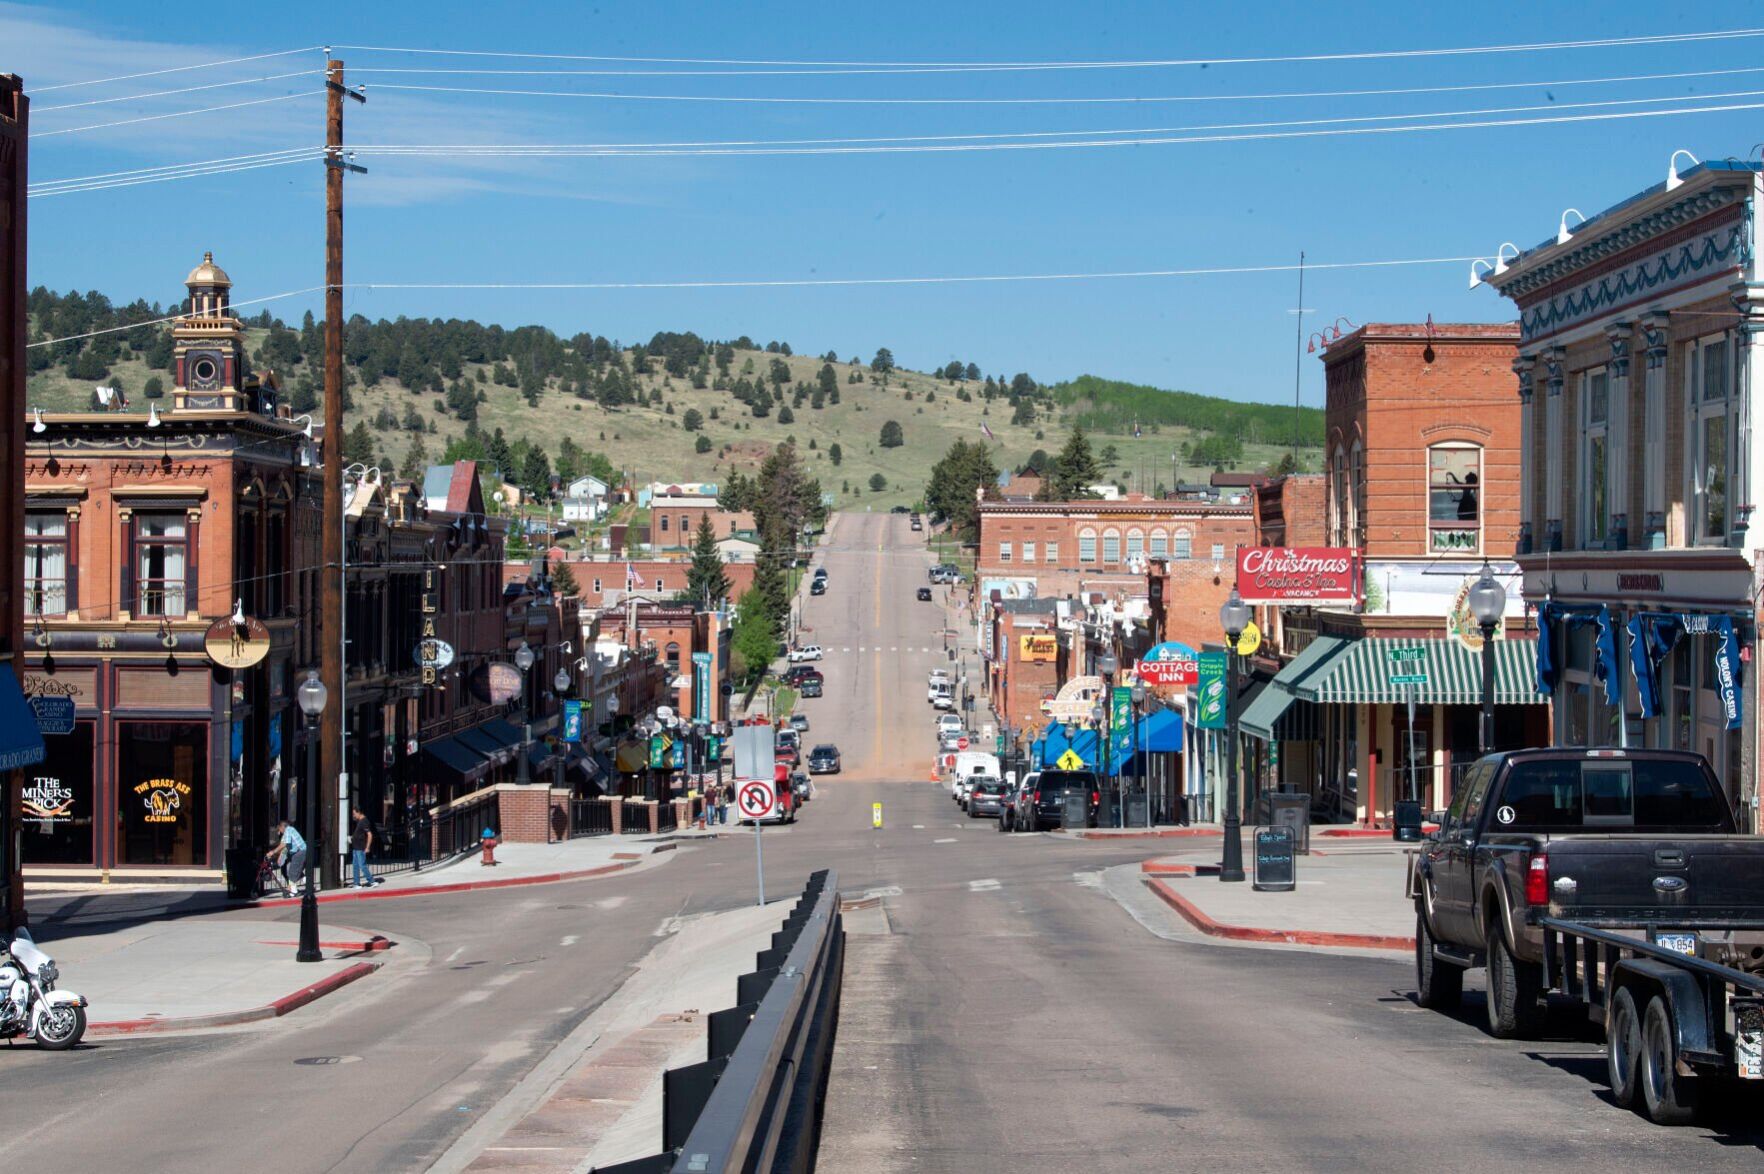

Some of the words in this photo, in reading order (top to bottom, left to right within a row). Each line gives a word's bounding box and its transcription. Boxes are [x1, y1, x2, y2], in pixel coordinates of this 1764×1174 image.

[1243, 549, 1349, 573] Christmas
[1255, 572, 1300, 588] Casino
[1399, 648, 1418, 660] Third
[1140, 662, 1199, 673] COTTAGE
[1158, 673, 1184, 682] INN
[1720, 656, 1732, 687] NOLON'S
[1726, 689, 1736, 719] CASINO
[32, 699, 73, 707] COLORADO
[37, 709, 63, 717] CASINO
[33, 777, 60, 788] THE
[134, 781, 150, 795] THE
[150, 779, 175, 788] BRASS
[175, 782, 191, 795] ASS
[22, 788, 72, 799] MINER'S
[33, 798, 62, 809] PICK
[1676, 937, 1693, 950] 854
